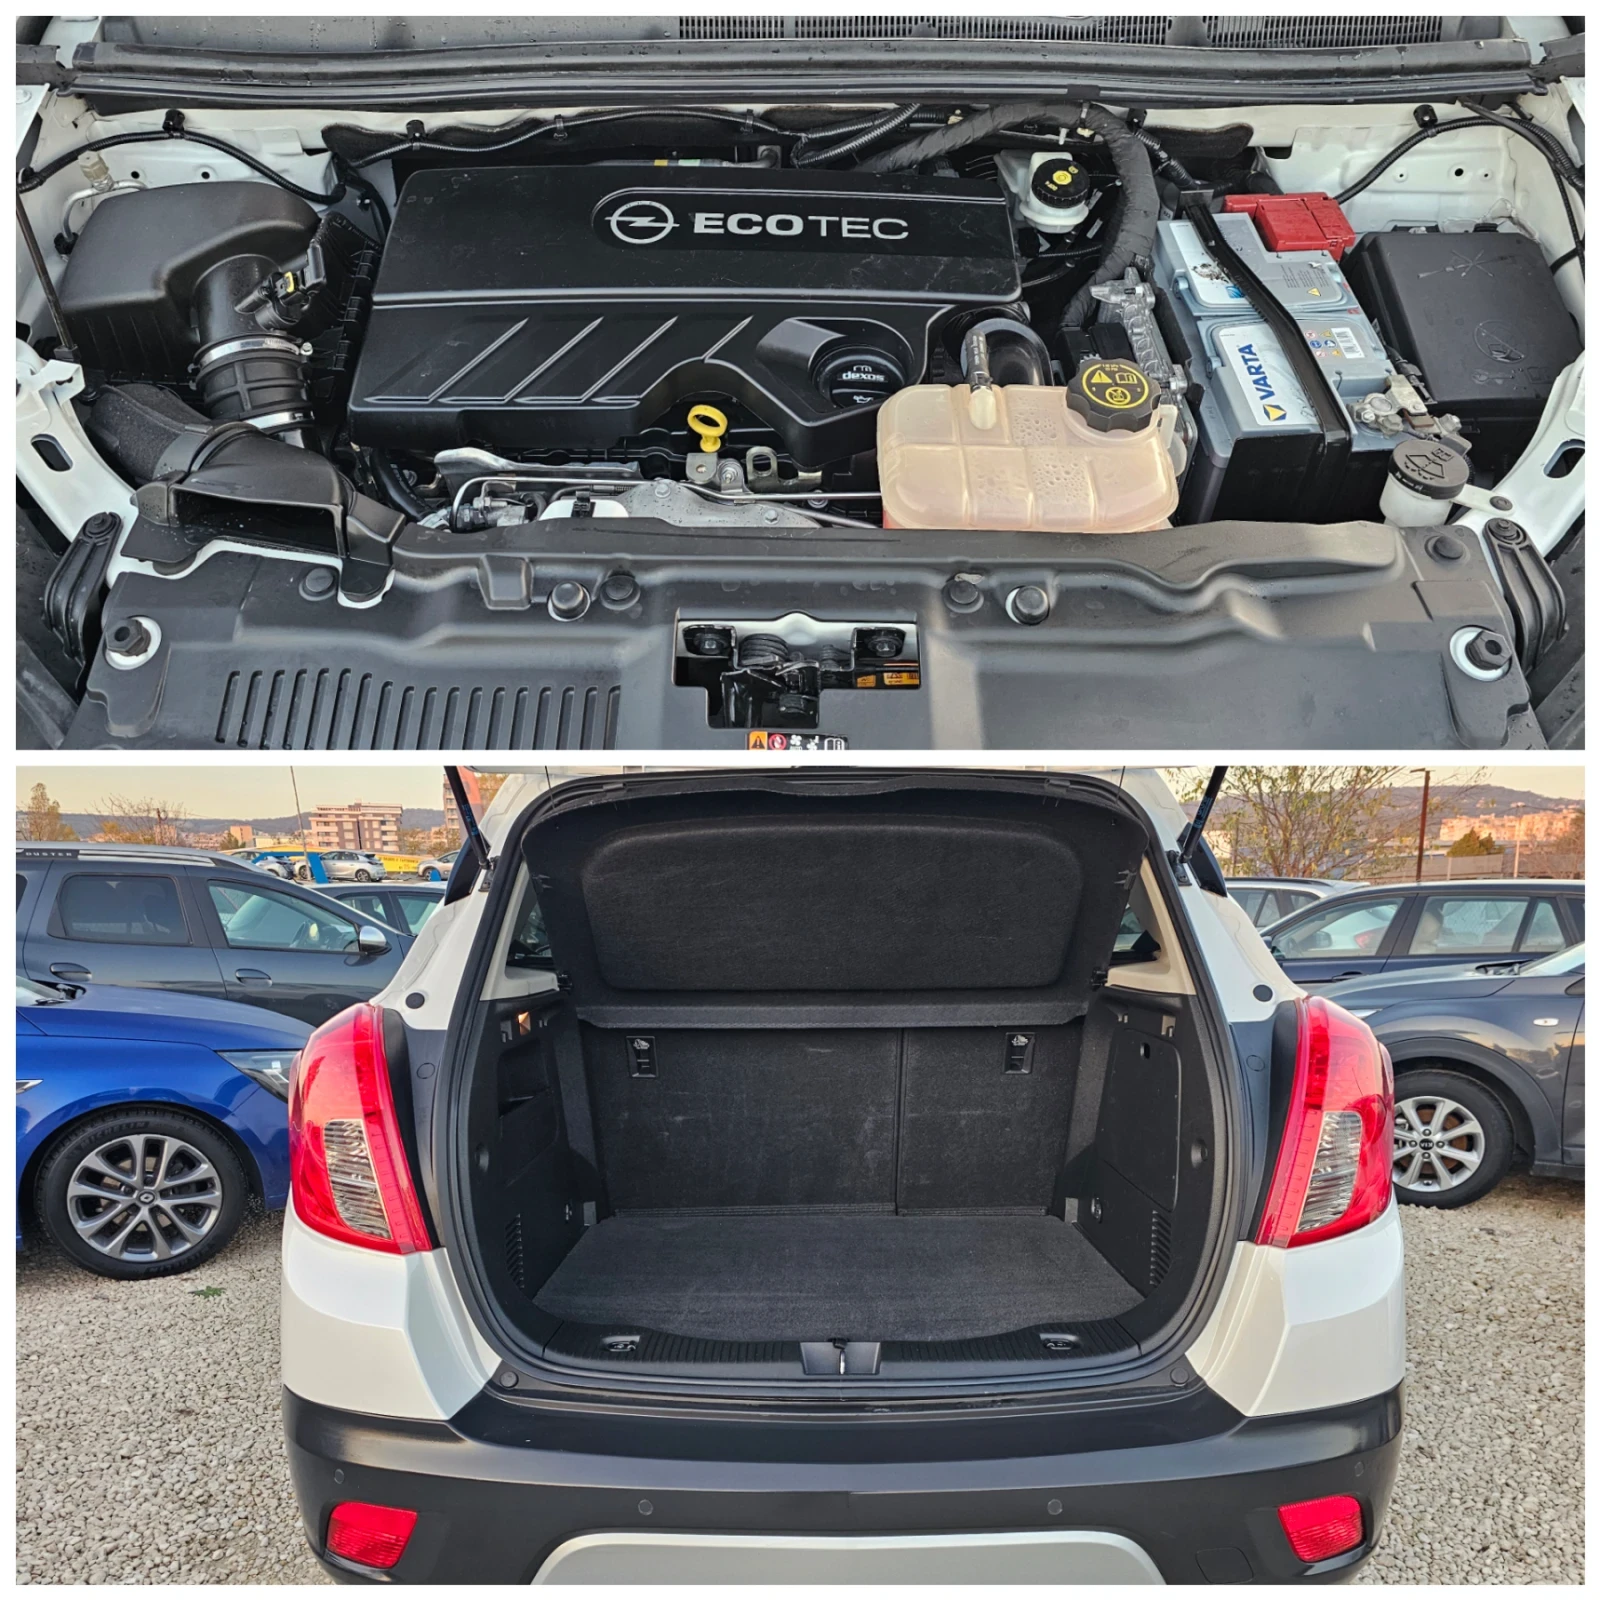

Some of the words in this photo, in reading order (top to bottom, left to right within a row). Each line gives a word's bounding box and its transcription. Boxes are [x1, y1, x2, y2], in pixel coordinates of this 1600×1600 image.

[693, 212, 909, 240] ECOTEC
[842, 371, 886, 382] dexos
[1238, 343, 1276, 401] VARTA
